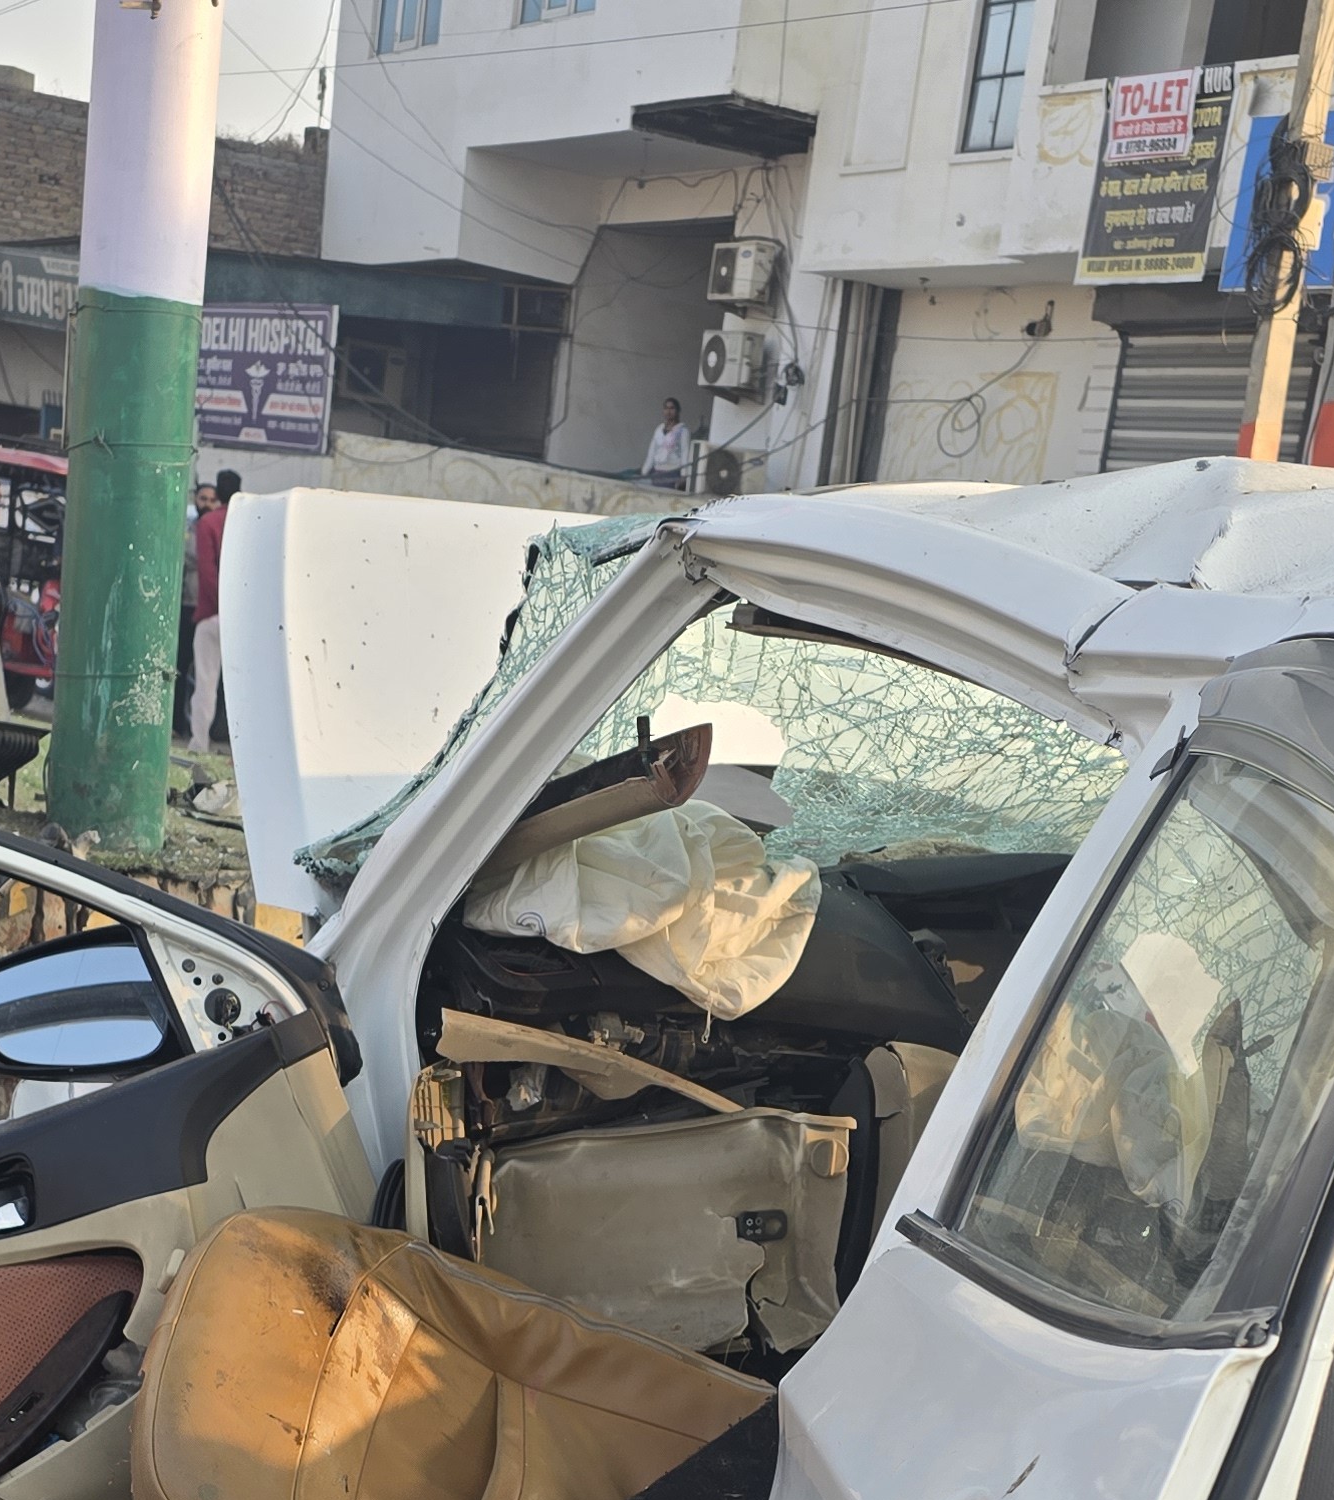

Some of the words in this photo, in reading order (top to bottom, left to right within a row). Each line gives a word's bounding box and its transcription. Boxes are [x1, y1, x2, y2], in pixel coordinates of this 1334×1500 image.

[1204, 66, 1232, 94] HUB
[201, 316, 246, 352] DELHI
[246, 317, 325, 356] HOSPITAL
